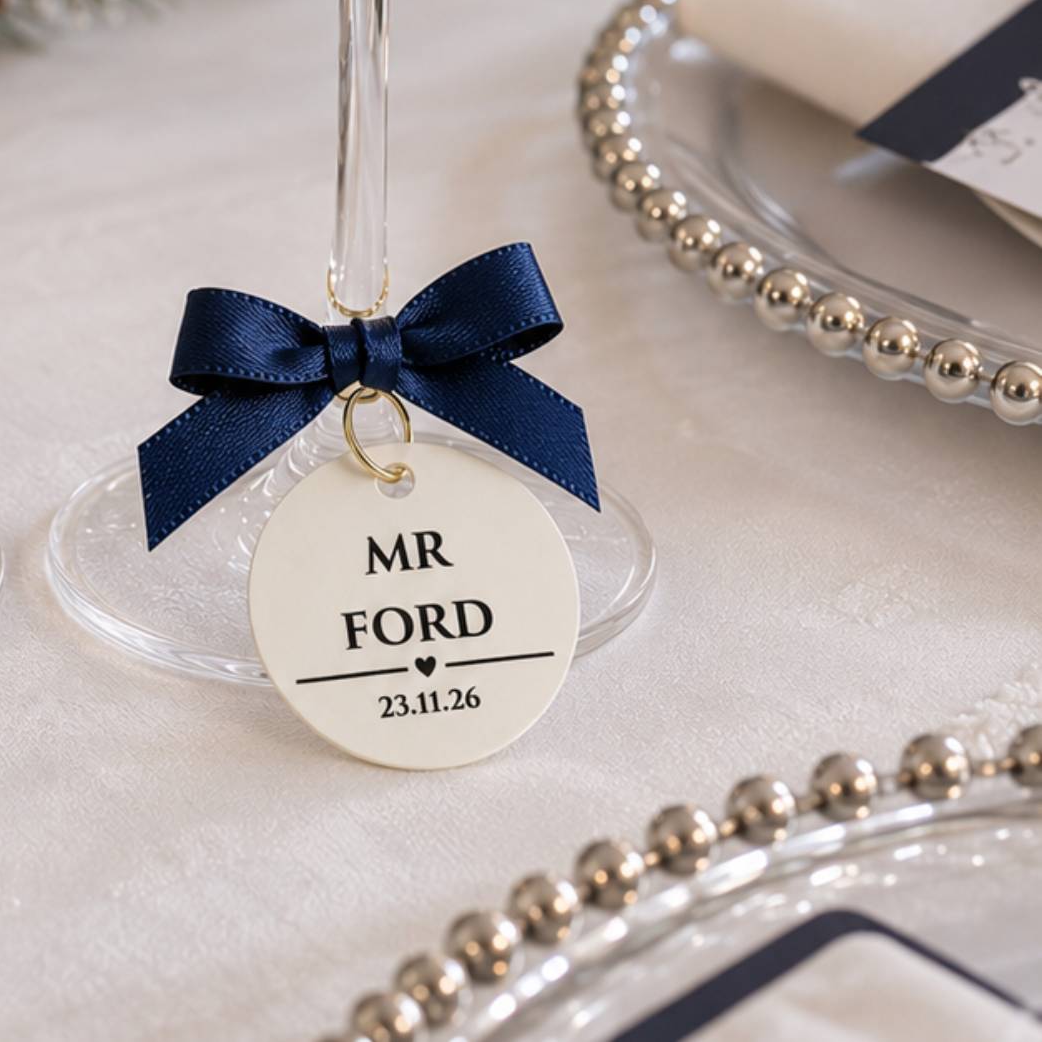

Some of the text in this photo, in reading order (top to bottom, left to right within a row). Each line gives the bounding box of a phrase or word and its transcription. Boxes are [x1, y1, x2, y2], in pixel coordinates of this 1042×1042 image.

[365, 530, 454, 576] MR
[341, 599, 493, 651] FORD
[378, 686, 481, 719] 23.11.26
